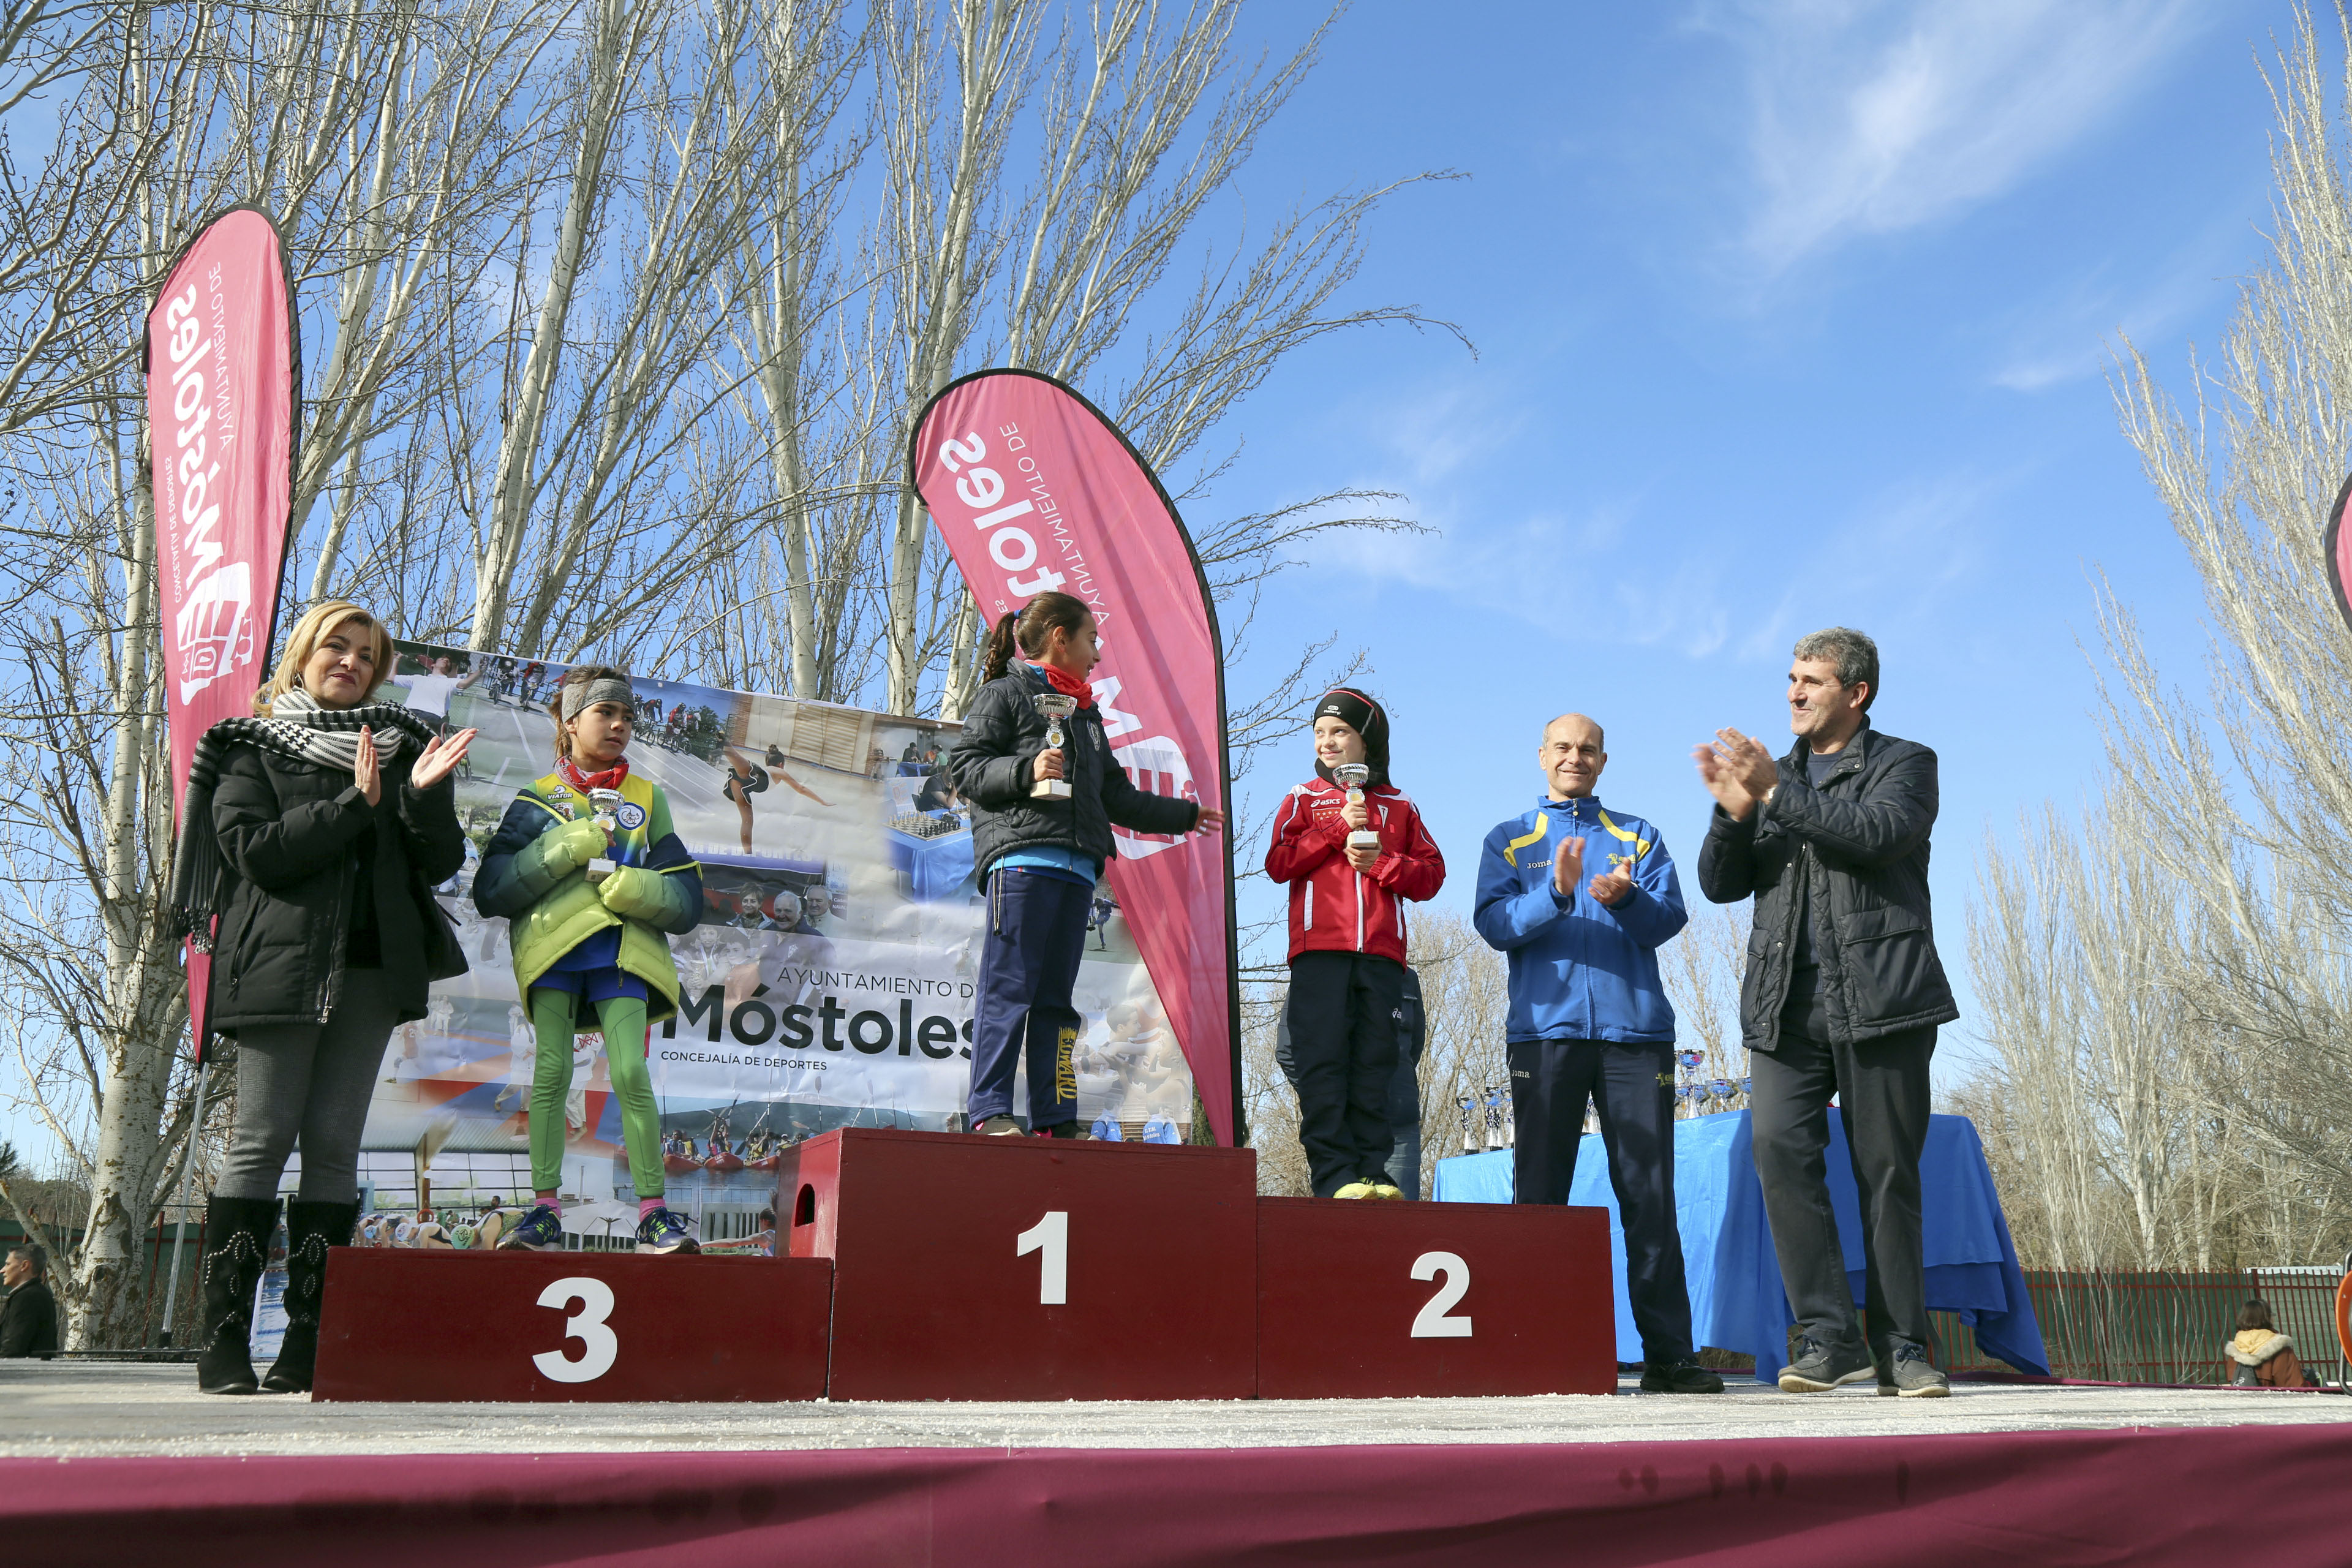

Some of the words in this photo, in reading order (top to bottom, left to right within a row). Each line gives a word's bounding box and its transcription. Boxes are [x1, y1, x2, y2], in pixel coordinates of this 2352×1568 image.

[777, 967, 952, 997] AYUNTAMIENTO
[960, 983, 978, 998] D
[661, 1050, 741, 1065] CONCEJALÍA
[745, 1057, 760, 1066] DE
[764, 1058, 827, 1071] DEPORTES
[1017, 1211, 1068, 1305] 1
[1411, 1251, 1472, 1338] 2
[532, 1276, 618, 1383] 3
